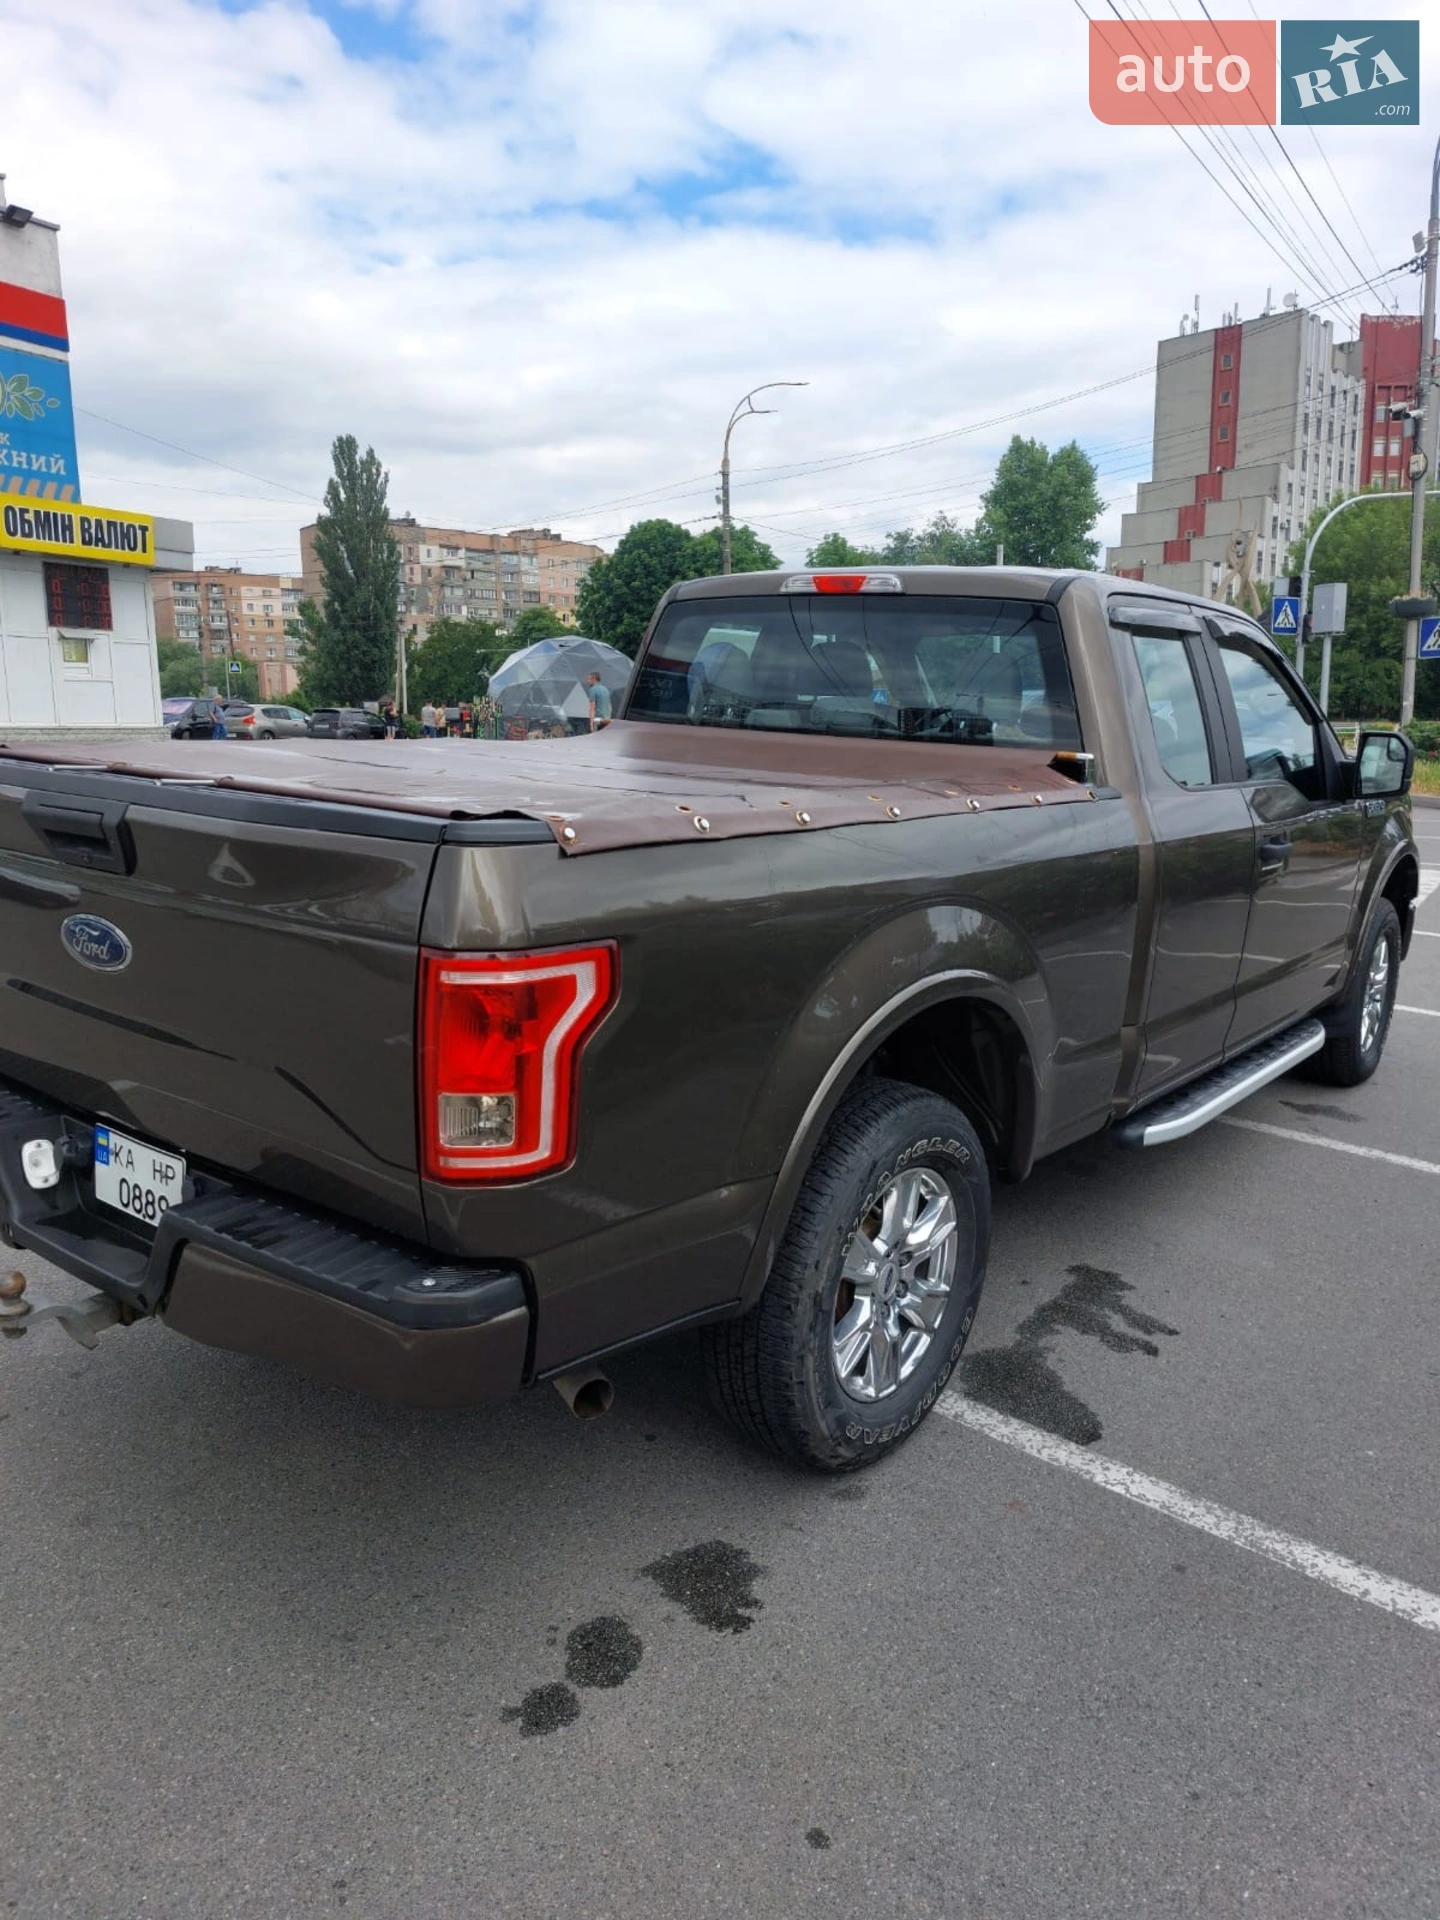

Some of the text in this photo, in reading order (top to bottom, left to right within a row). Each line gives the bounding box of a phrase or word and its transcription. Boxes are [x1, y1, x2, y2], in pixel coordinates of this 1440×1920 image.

[4, 505, 149, 554] ОБМІН ВАЛЮТ
[70, 924, 111, 961] Ford
[98, 1149, 109, 1163] UA
[114, 1142, 176, 1187] KA HP
